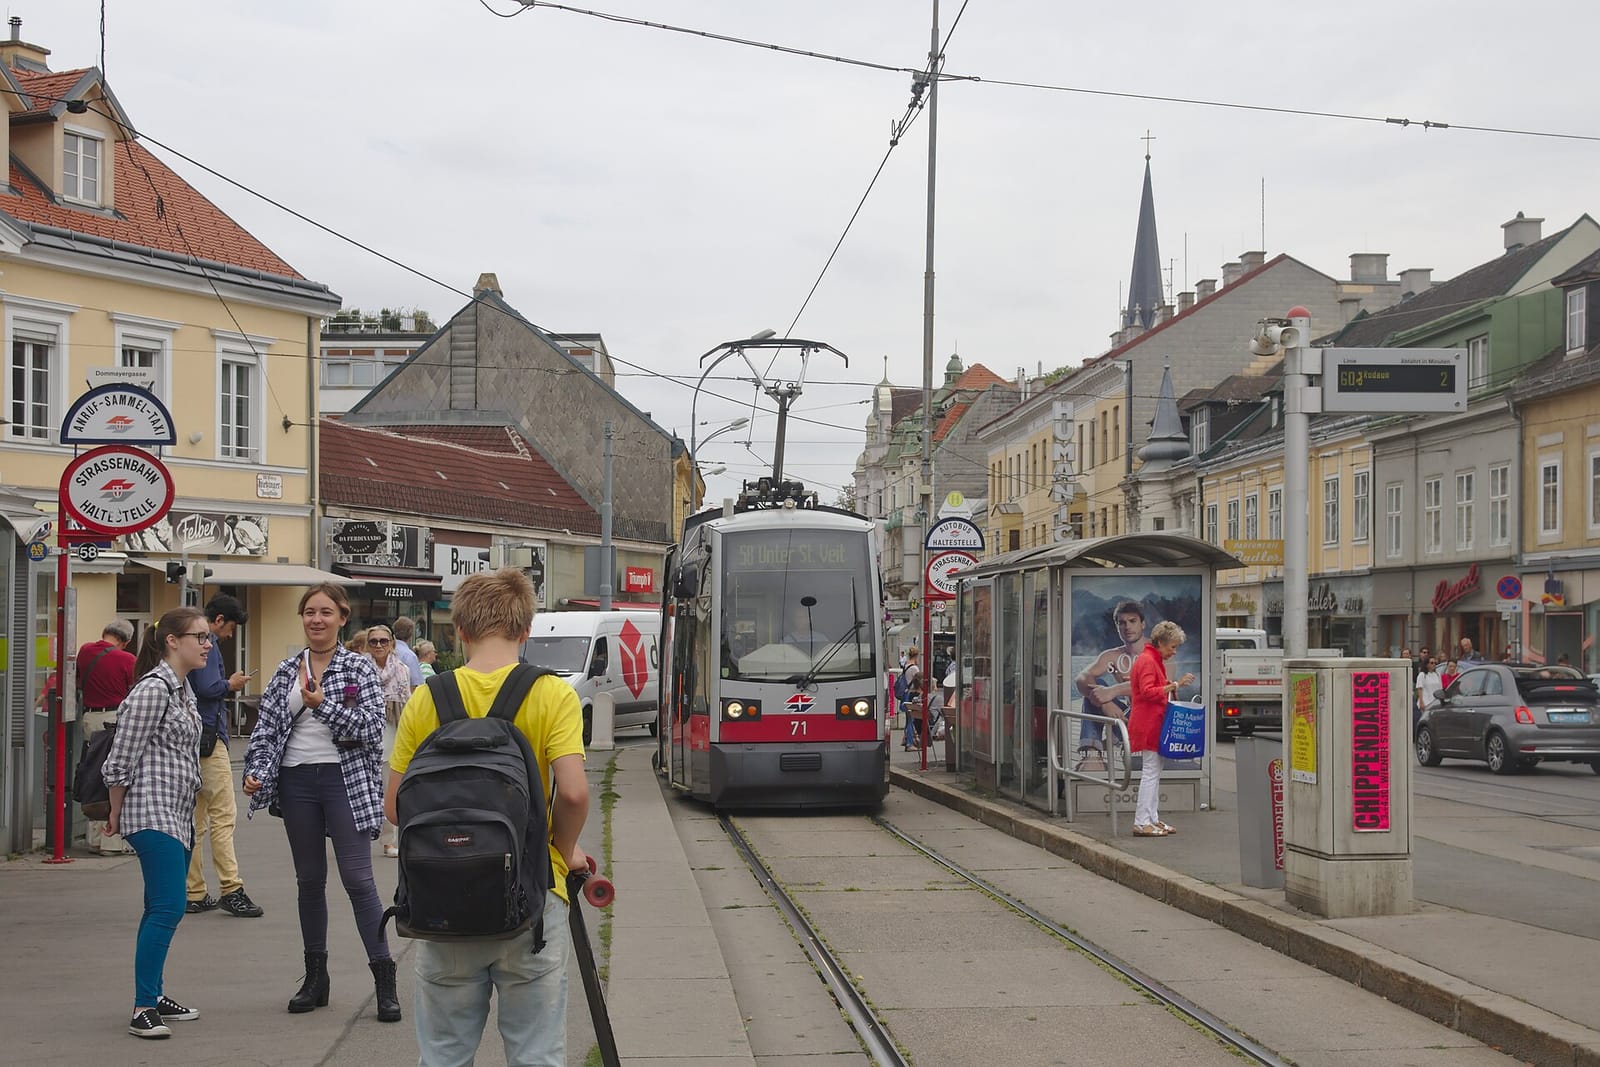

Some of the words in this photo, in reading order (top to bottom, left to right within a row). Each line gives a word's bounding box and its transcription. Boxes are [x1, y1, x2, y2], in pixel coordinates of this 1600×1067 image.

[1340, 371, 1355, 386] 60
[1440, 371, 1448, 386] 2
[73, 394, 166, 436] ANRUF-SAMMEL-TAXI
[76, 457, 160, 487] STRASSENBAHN
[1052, 401, 1075, 541] HUMANIC
[181, 514, 216, 541] Felber
[940, 522, 972, 534] AUTOBUS
[79, 547, 97, 558] 58
[759, 544, 793, 564] Unter
[819, 544, 846, 563] Veit
[629, 572, 646, 588] Triumph
[385, 587, 413, 597] PIZZERIA
[1379, 683, 1389, 743] STADTHALLE
[790, 721, 807, 736] 71
[1169, 742, 1196, 752] DELKA
[1354, 673, 1380, 829] CHIPPENDALES
[1379, 747, 1389, 784] WIENER
